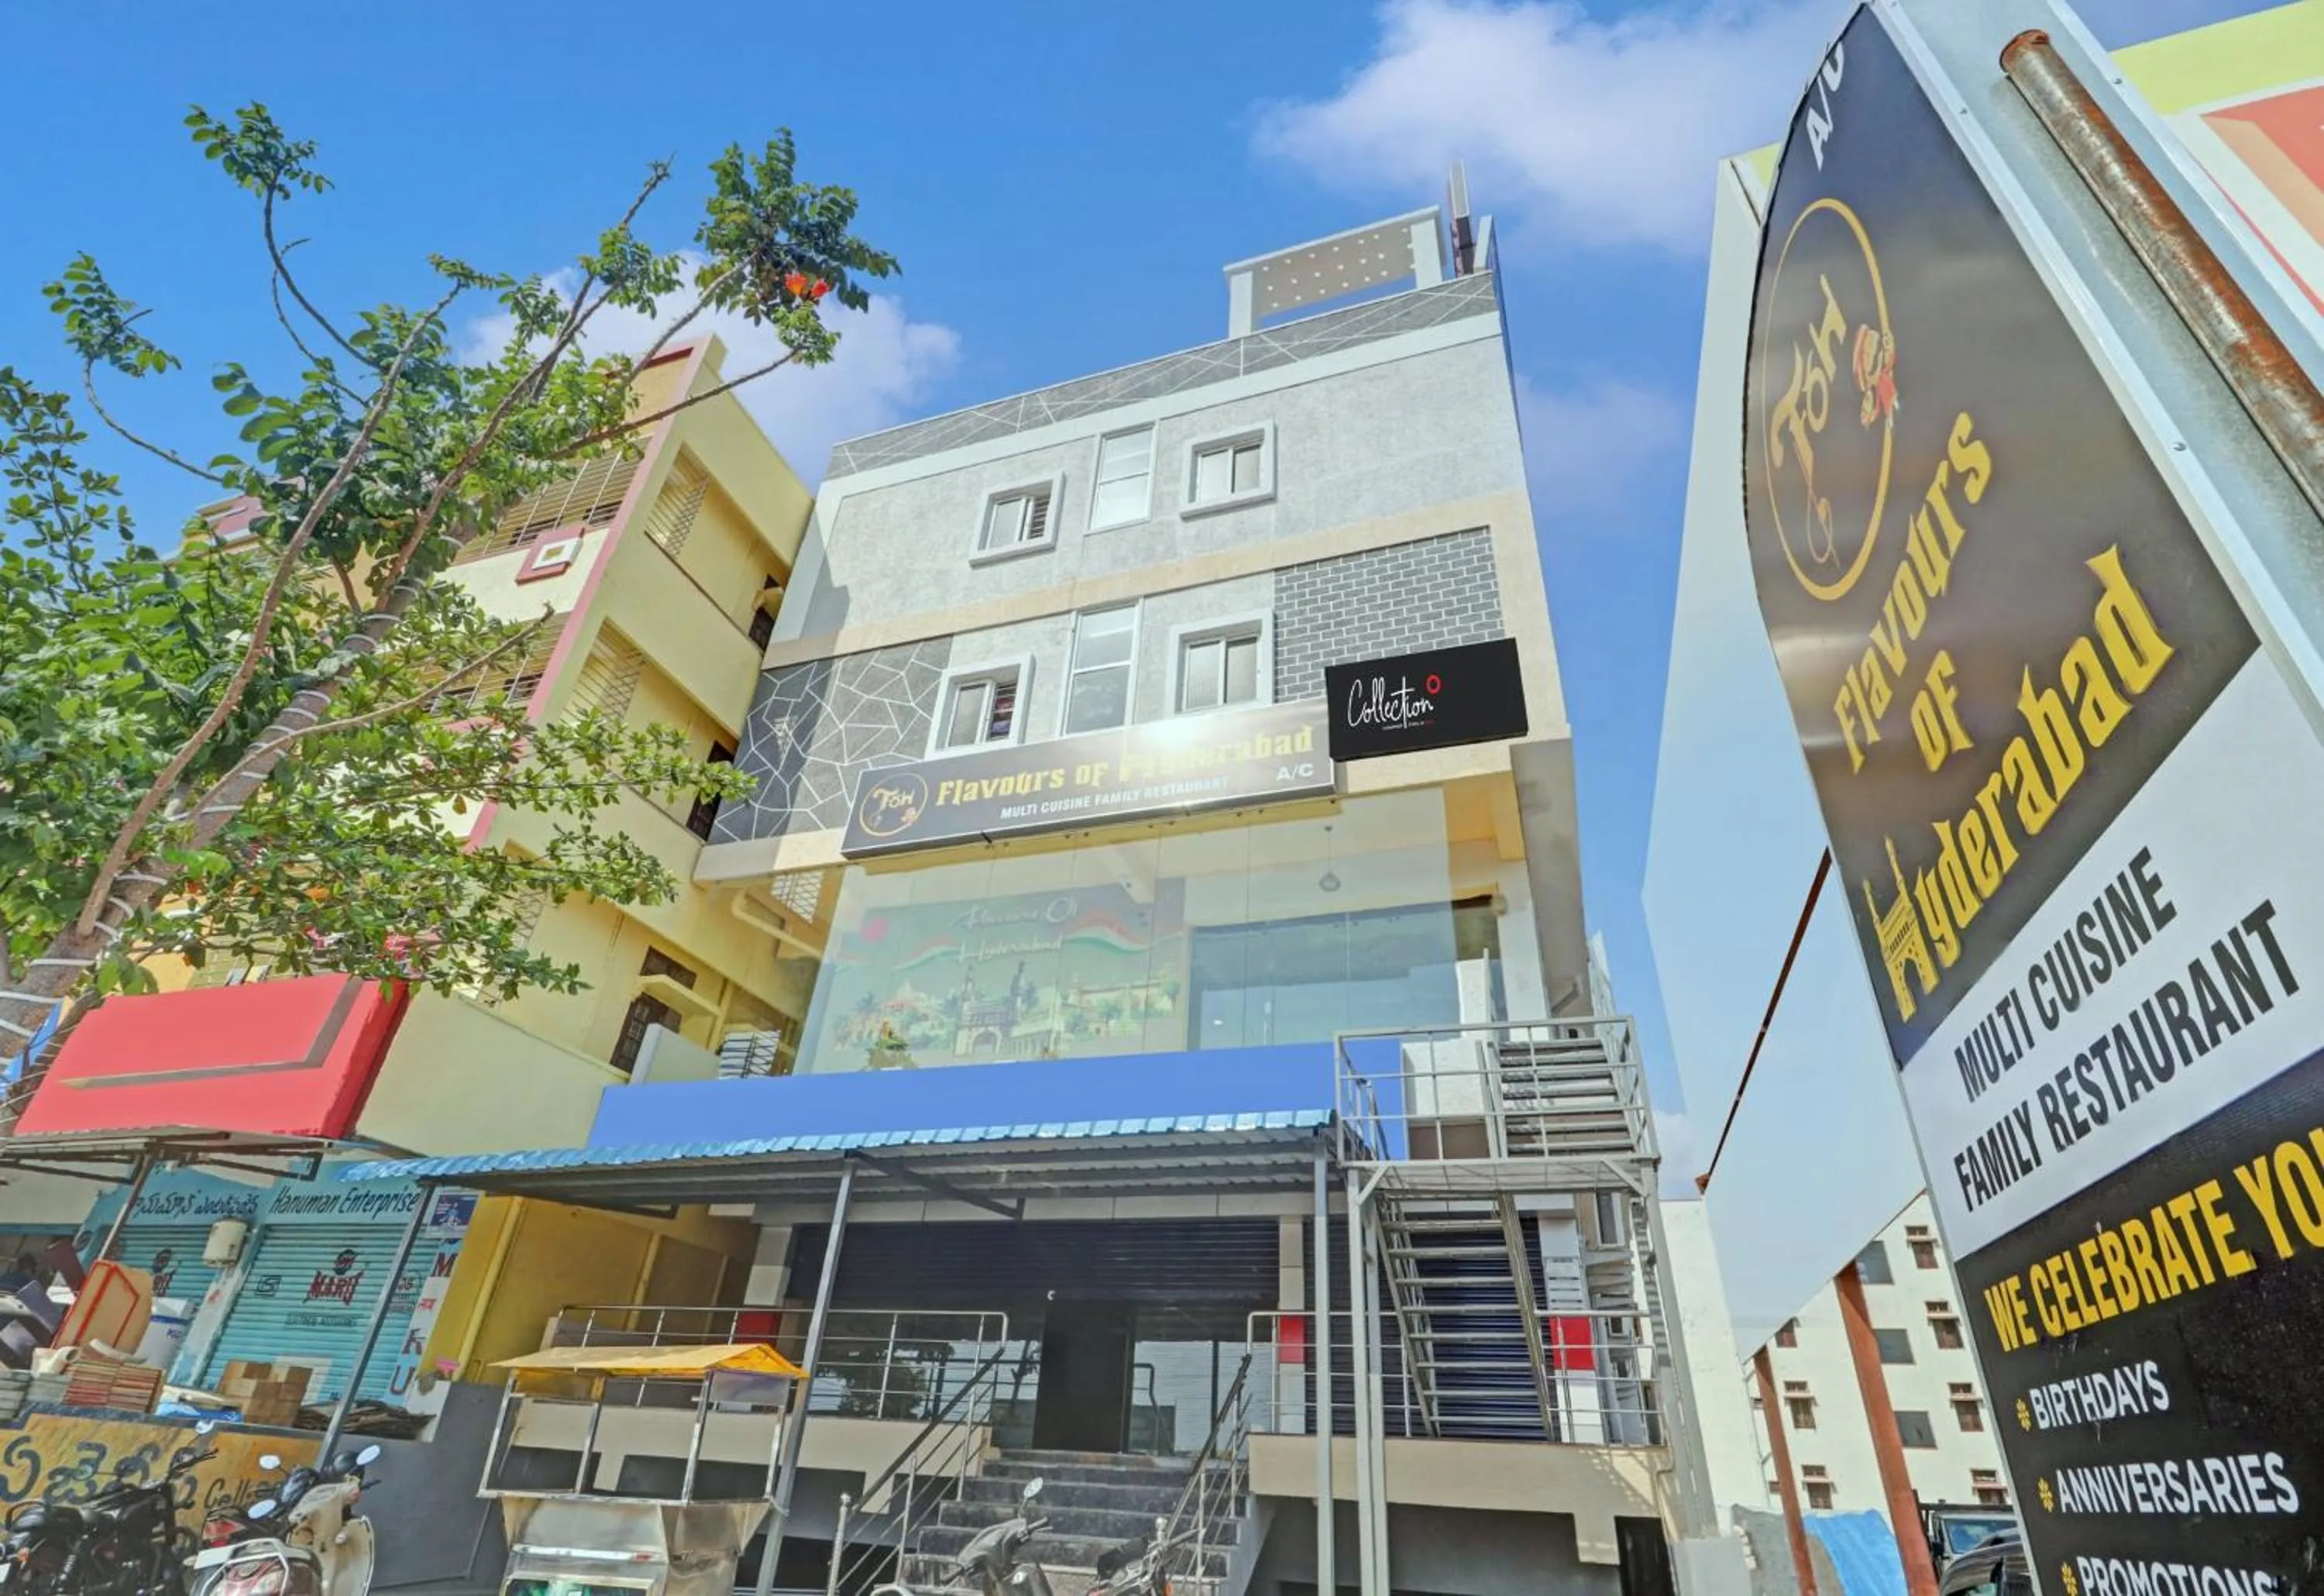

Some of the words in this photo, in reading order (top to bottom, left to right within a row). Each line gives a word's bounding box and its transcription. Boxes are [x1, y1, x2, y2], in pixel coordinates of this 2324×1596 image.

[1834, 411, 1992, 775] Flavours
[1347, 676, 1434, 728] Collection
[935, 768, 1065, 807] Flavours
[1277, 763, 1315, 781] A/C
[1000, 804, 1037, 820] MULTI
[1040, 795, 1091, 813] CUISINE
[1095, 789, 1140, 807] FAMILY
[1954, 987, 2036, 1103] MULTI
[2027, 845, 2178, 1031] CUISINE
[1953, 1100, 2043, 1212] FAMILY
[2036, 899, 2300, 1153] RESTAURANT
[269, 1185, 341, 1214] Hanuman
[1983, 1276, 2038, 1353] WE
[2029, 1178, 2257, 1337] CELEBRATE
[2029, 1360, 2169, 1430] BIRTHDAYS
[2056, 1452, 2299, 1513] ANNIVERSARIES
